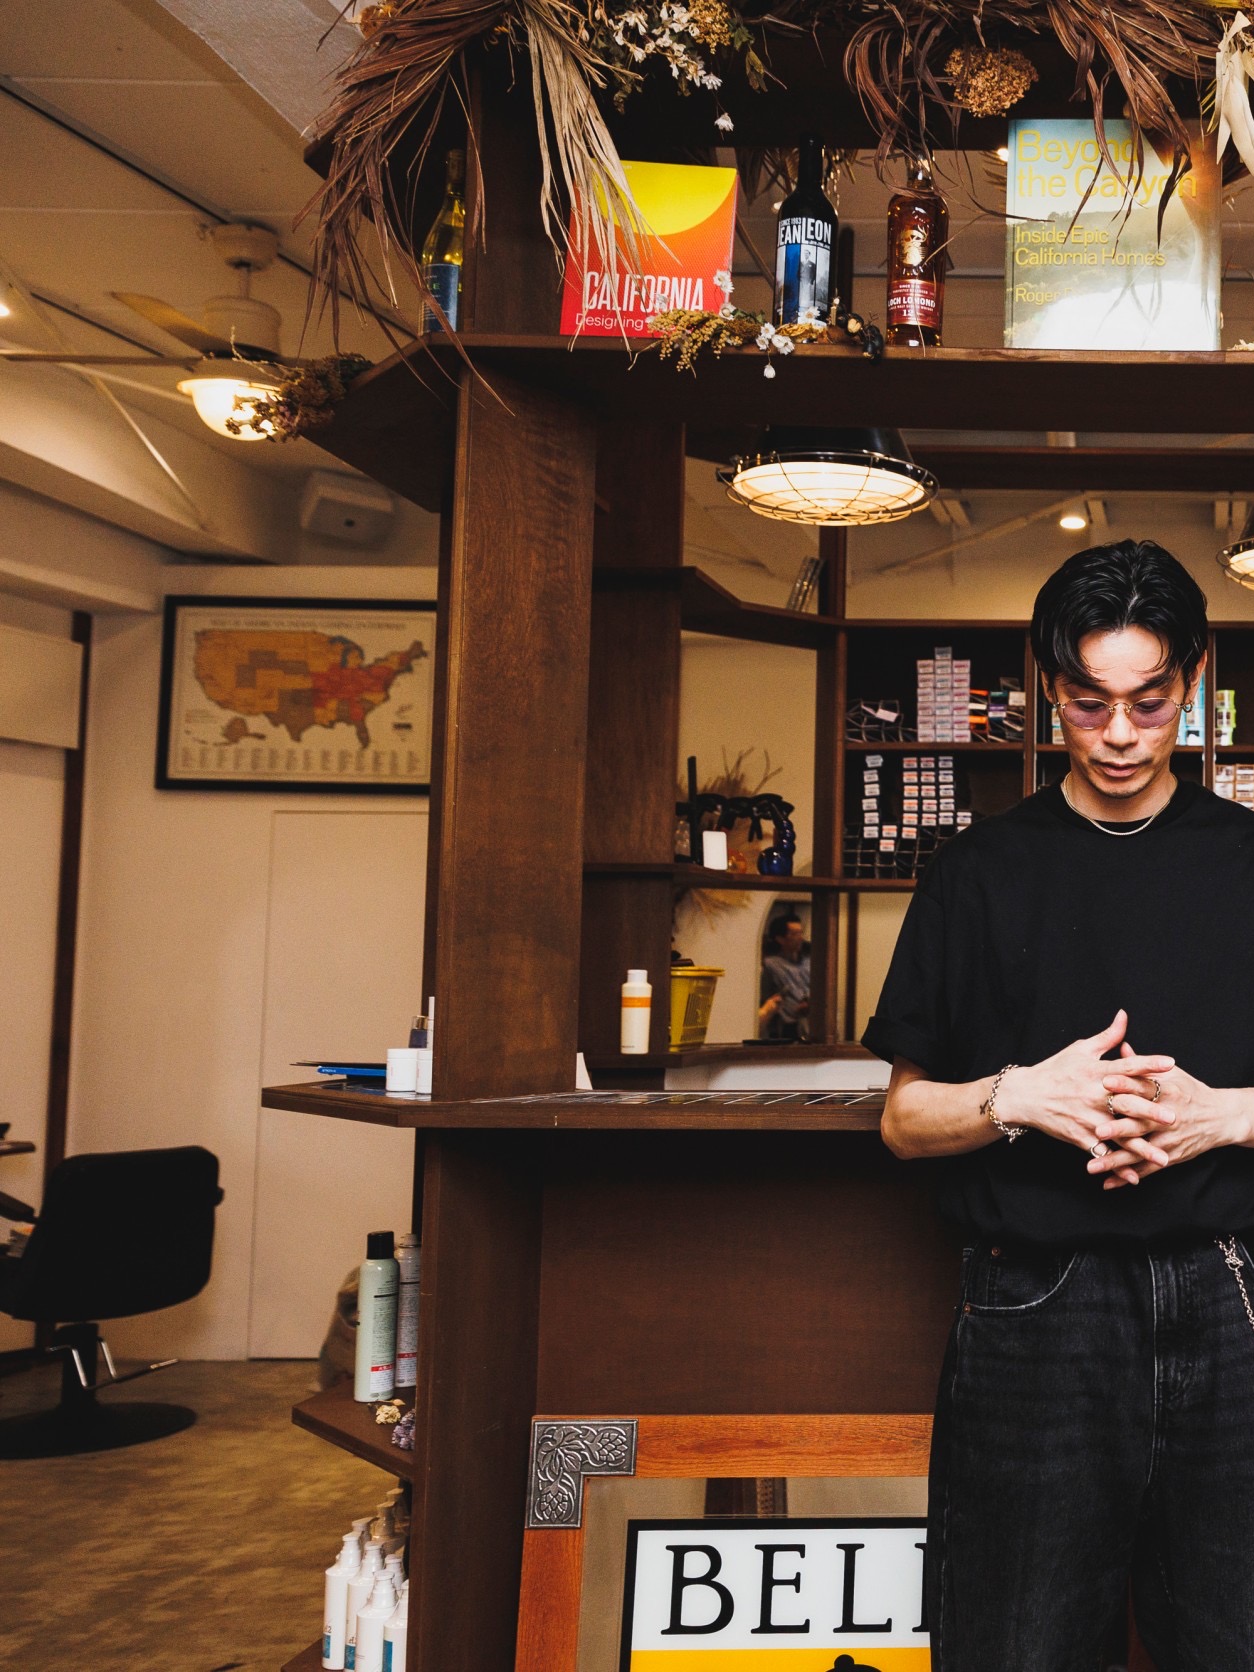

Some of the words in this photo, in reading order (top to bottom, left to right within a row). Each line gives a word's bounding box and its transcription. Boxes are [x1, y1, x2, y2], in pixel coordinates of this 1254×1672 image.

[1017, 129, 1140, 169] Beyond
[1017, 165, 1067, 198] the
[801, 217, 832, 245] LEON
[1015, 225, 1067, 244] Inside
[1071, 225, 1109, 246] Epic
[1015, 247, 1098, 266] California
[1101, 249, 1166, 266] Homes
[584, 271, 704, 313] CALIFORNIA
[902, 296, 936, 308] LOMOND
[1015, 287, 1060, 306] Roger
[575, 313, 644, 330] Designing
